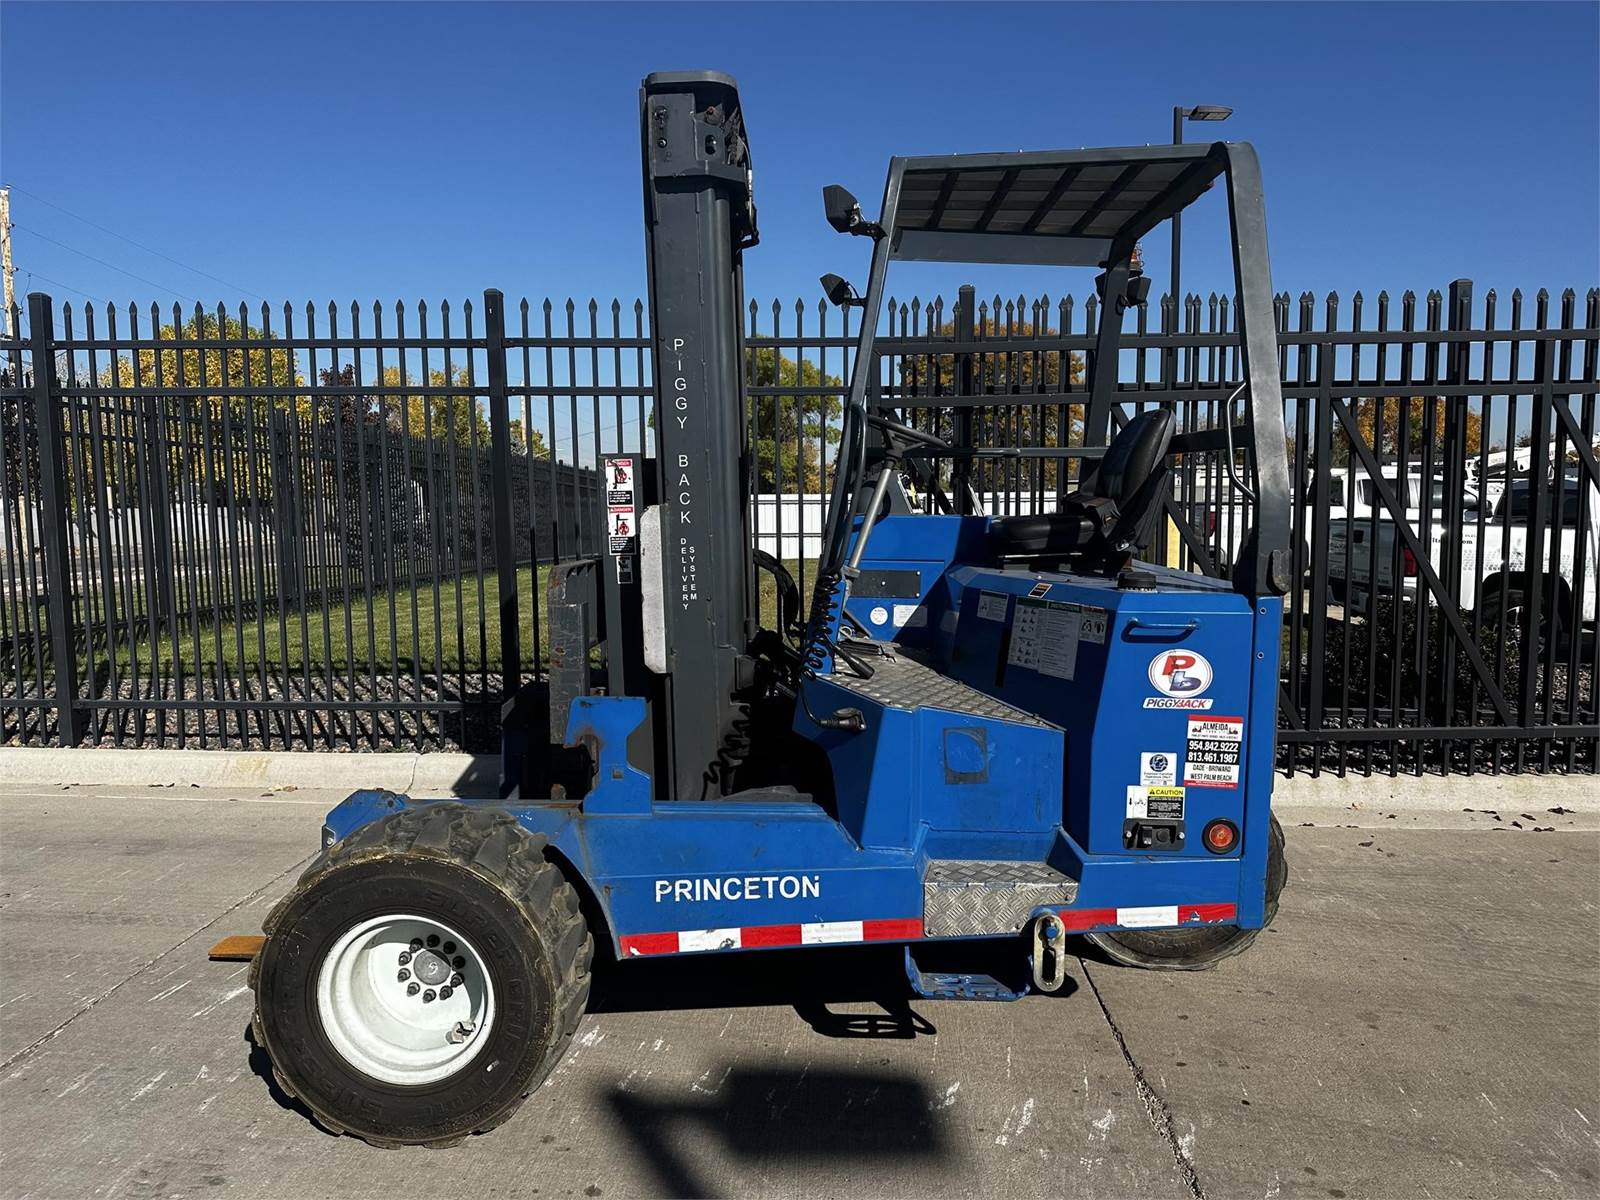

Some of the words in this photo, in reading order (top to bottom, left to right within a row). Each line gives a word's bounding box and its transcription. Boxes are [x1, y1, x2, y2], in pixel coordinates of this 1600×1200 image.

[673, 338, 688, 430] PIGGY
[678, 454, 692, 524] BACK
[680, 538, 689, 611] DELIVERY
[689, 546, 698, 600] SYSTEM
[1188, 740, 1239, 752] 954.842.9222
[1202, 722, 1228, 731] ALMEIDA
[1187, 752, 1238, 763] 813.461.1987
[655, 875, 820, 903] PRINCETON
